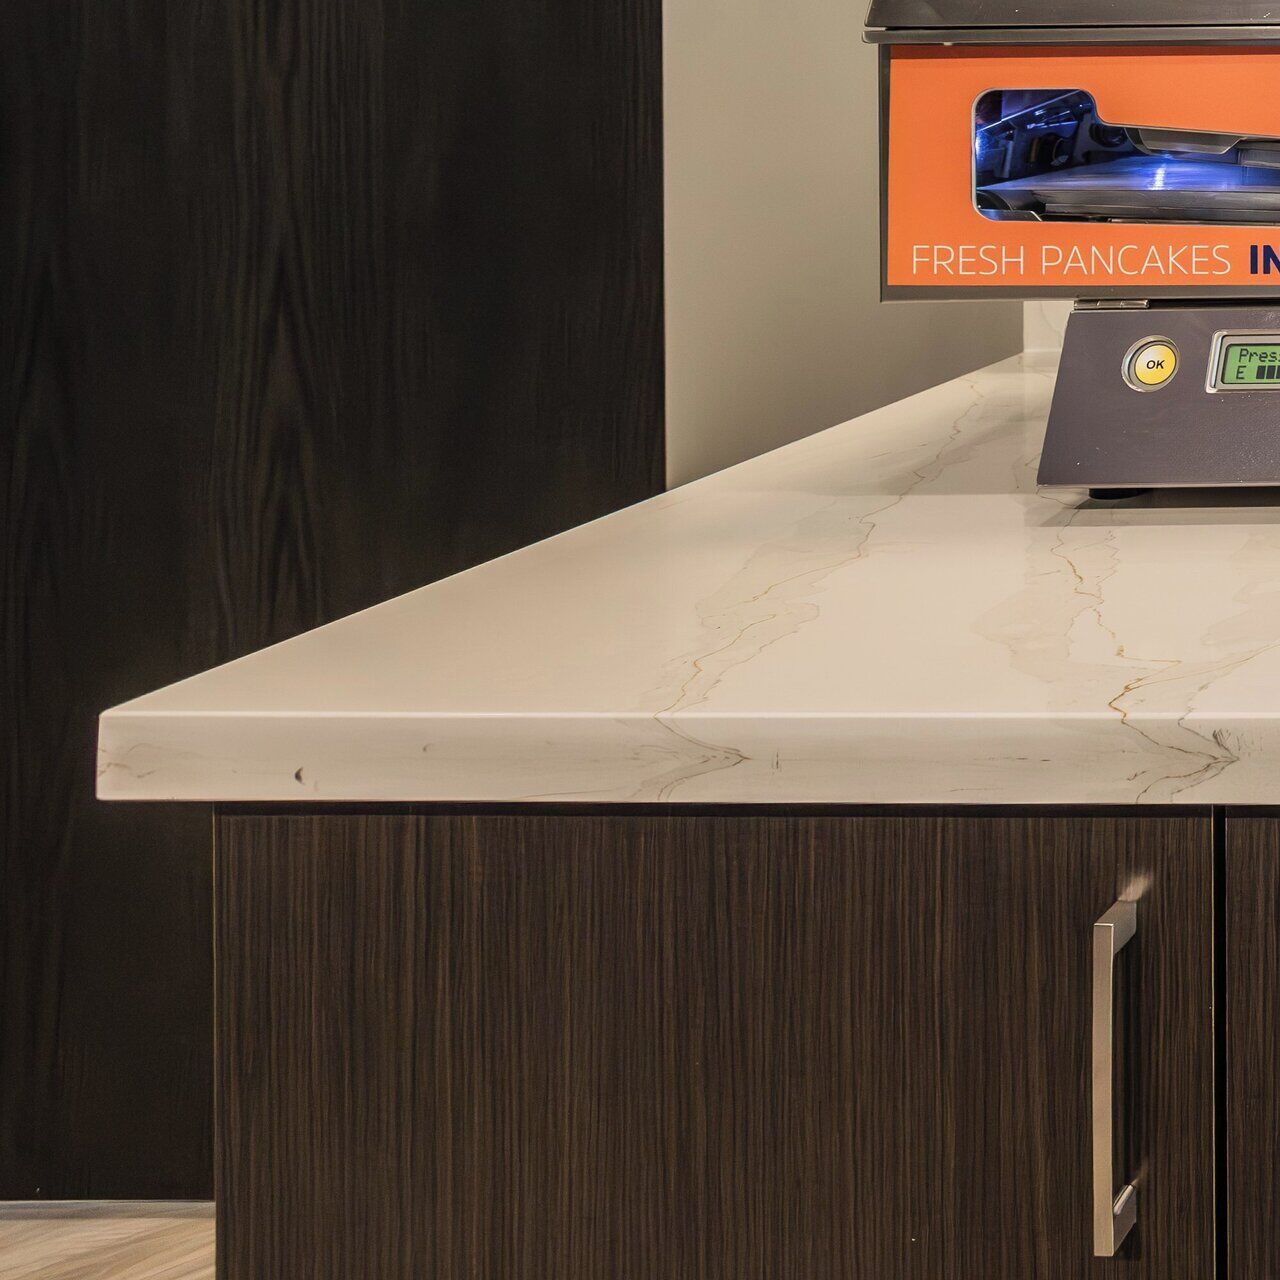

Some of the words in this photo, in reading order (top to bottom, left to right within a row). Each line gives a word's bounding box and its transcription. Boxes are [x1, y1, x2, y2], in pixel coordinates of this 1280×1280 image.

[911, 244, 1025, 276] FRESH
[1041, 244, 1232, 276] PANCAKES
[1146, 359, 1166, 370] OK
[1235, 365, 1247, 380] E
